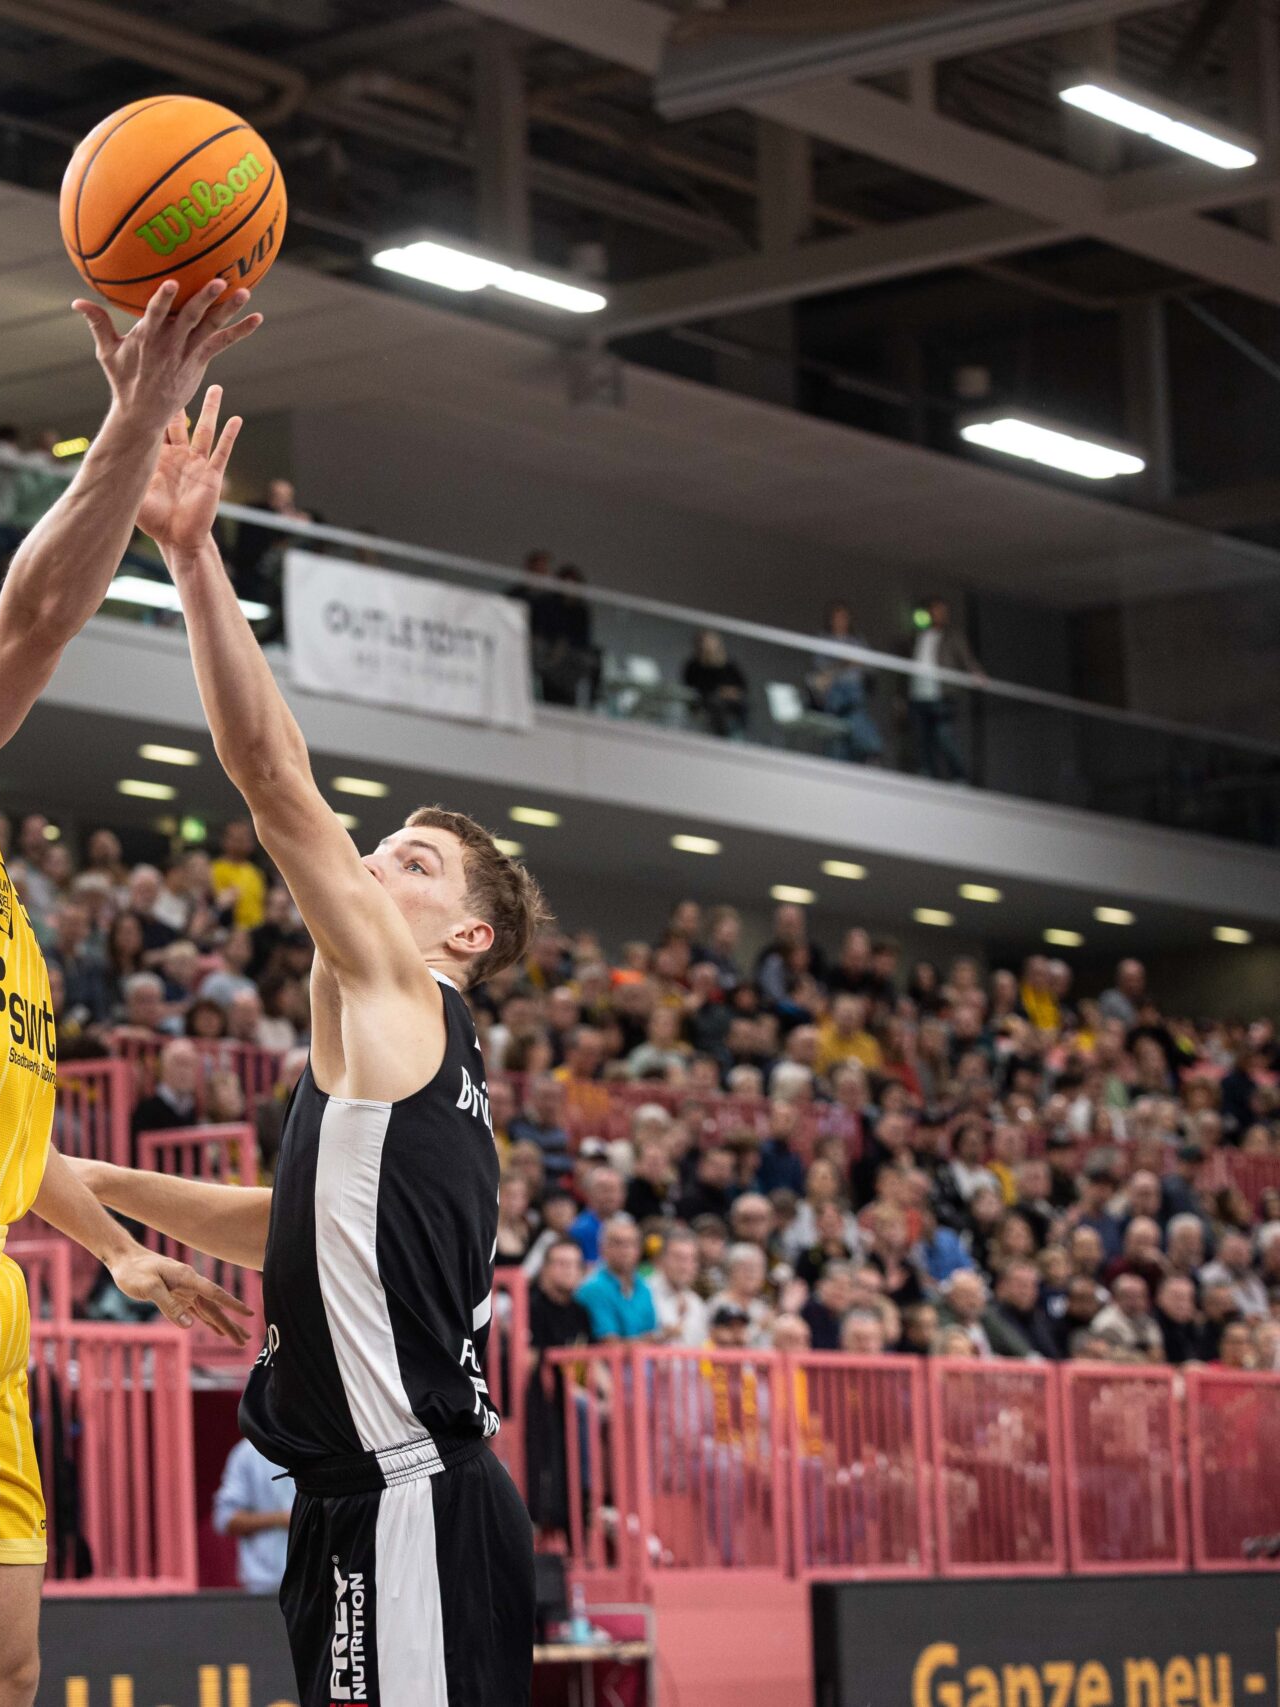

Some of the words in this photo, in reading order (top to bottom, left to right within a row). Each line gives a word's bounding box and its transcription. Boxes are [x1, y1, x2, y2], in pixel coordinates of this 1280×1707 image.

[136, 153, 265, 256] Wilson
[8, 992, 56, 1062] swt
[456, 1066, 494, 1139] Brü
[349, 1573, 367, 1700] NUTRITION
[913, 1641, 1112, 1707] Ganze
[1125, 1652, 1232, 1707] neu
